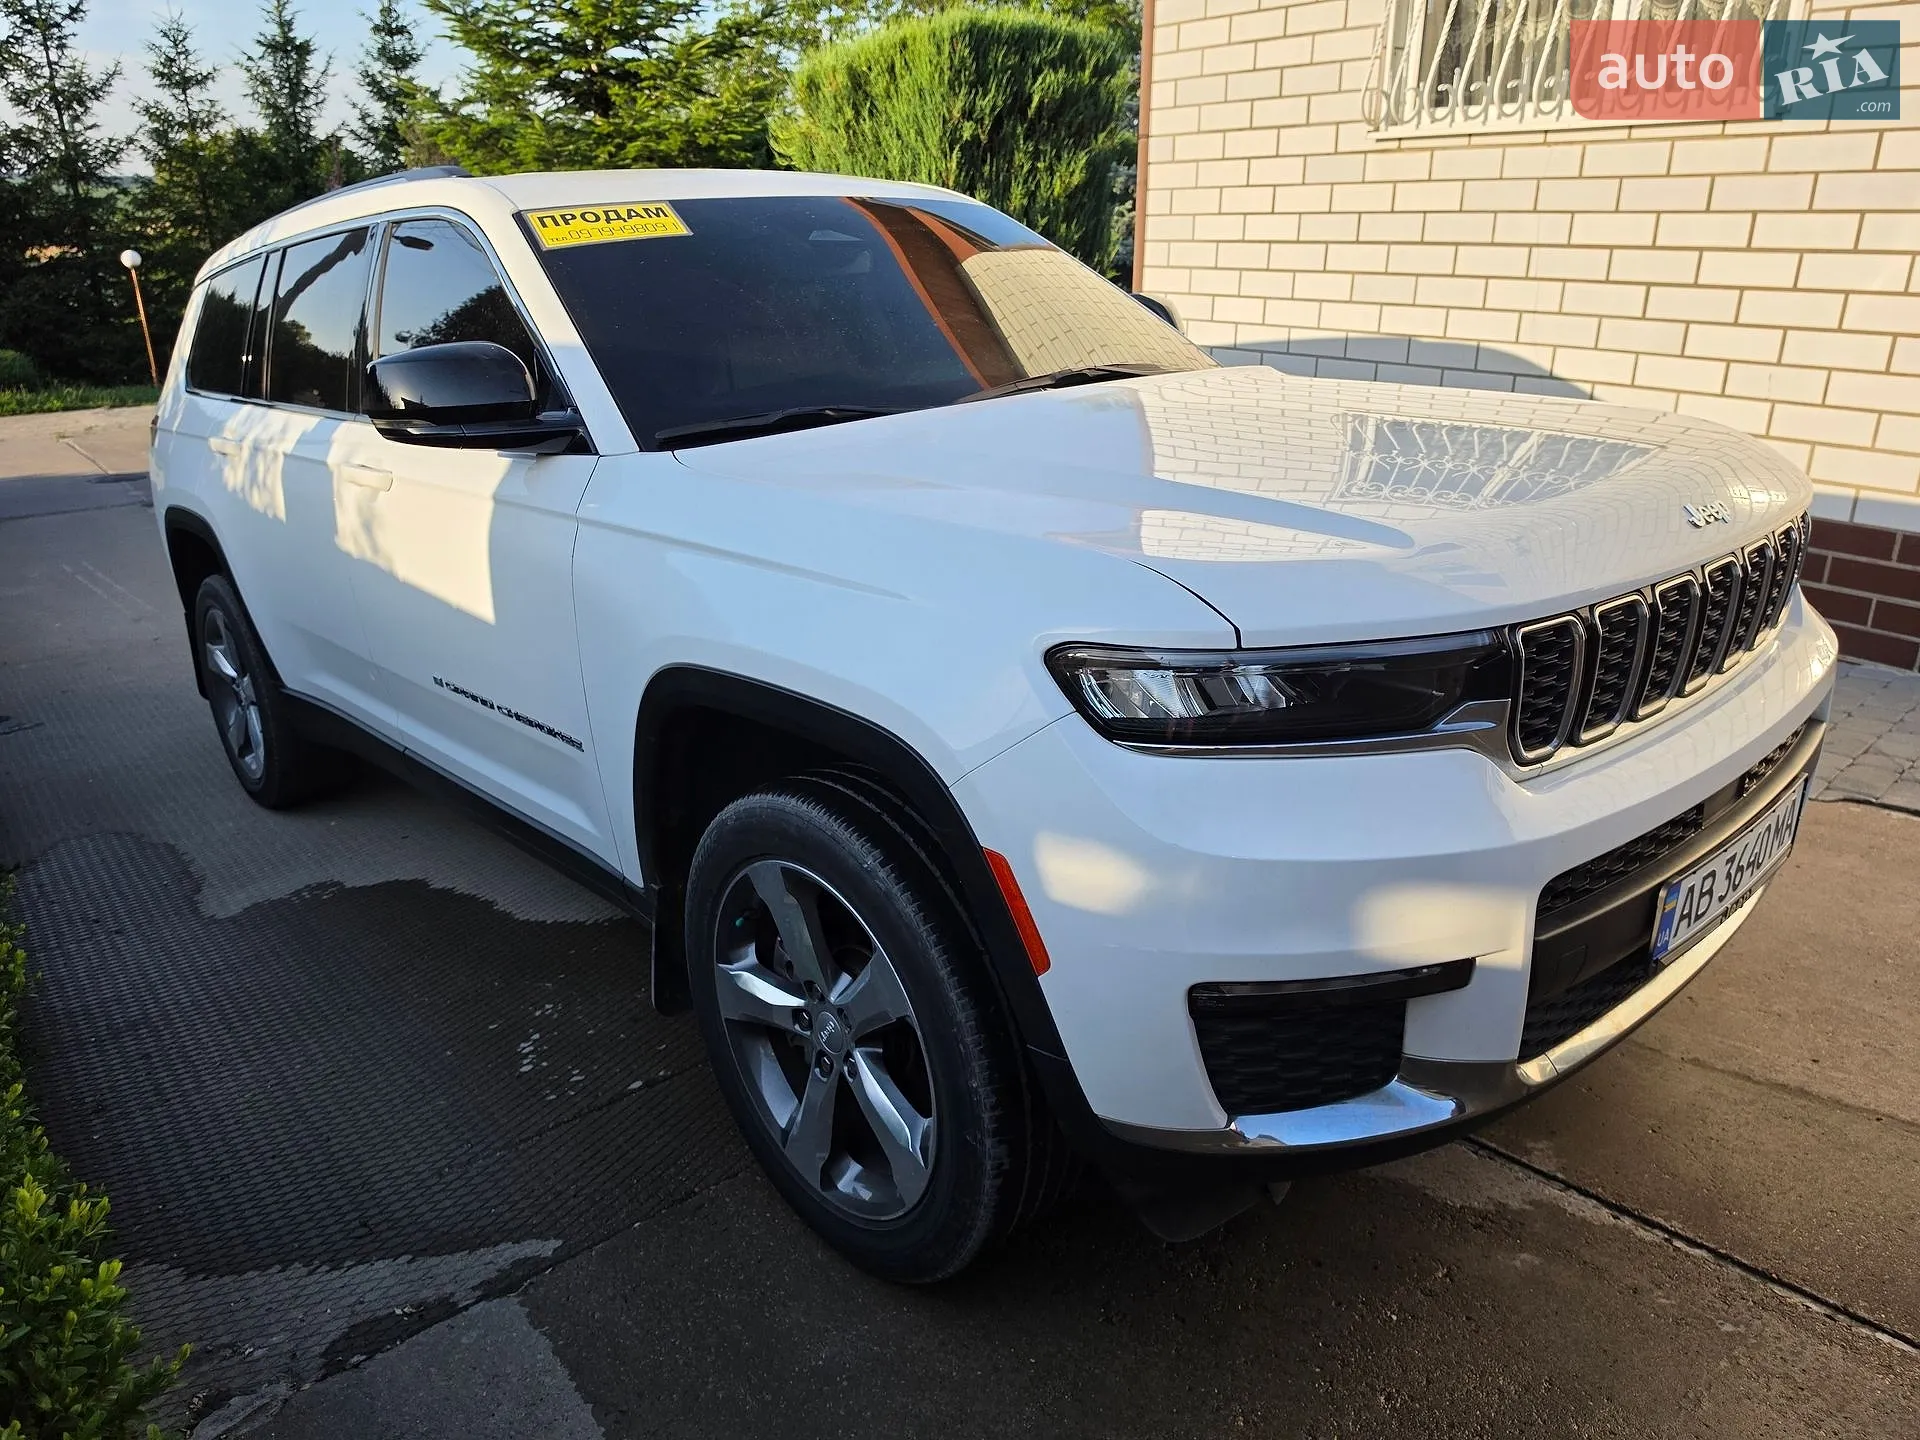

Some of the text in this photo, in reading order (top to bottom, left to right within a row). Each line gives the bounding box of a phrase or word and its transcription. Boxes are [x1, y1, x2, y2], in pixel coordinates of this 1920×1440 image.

[537, 206, 669, 229] ПРОДАМ
[1682, 501, 1731, 529] Jeep
[1673, 868, 1717, 938] AB
[1656, 927, 1670, 947] UA
